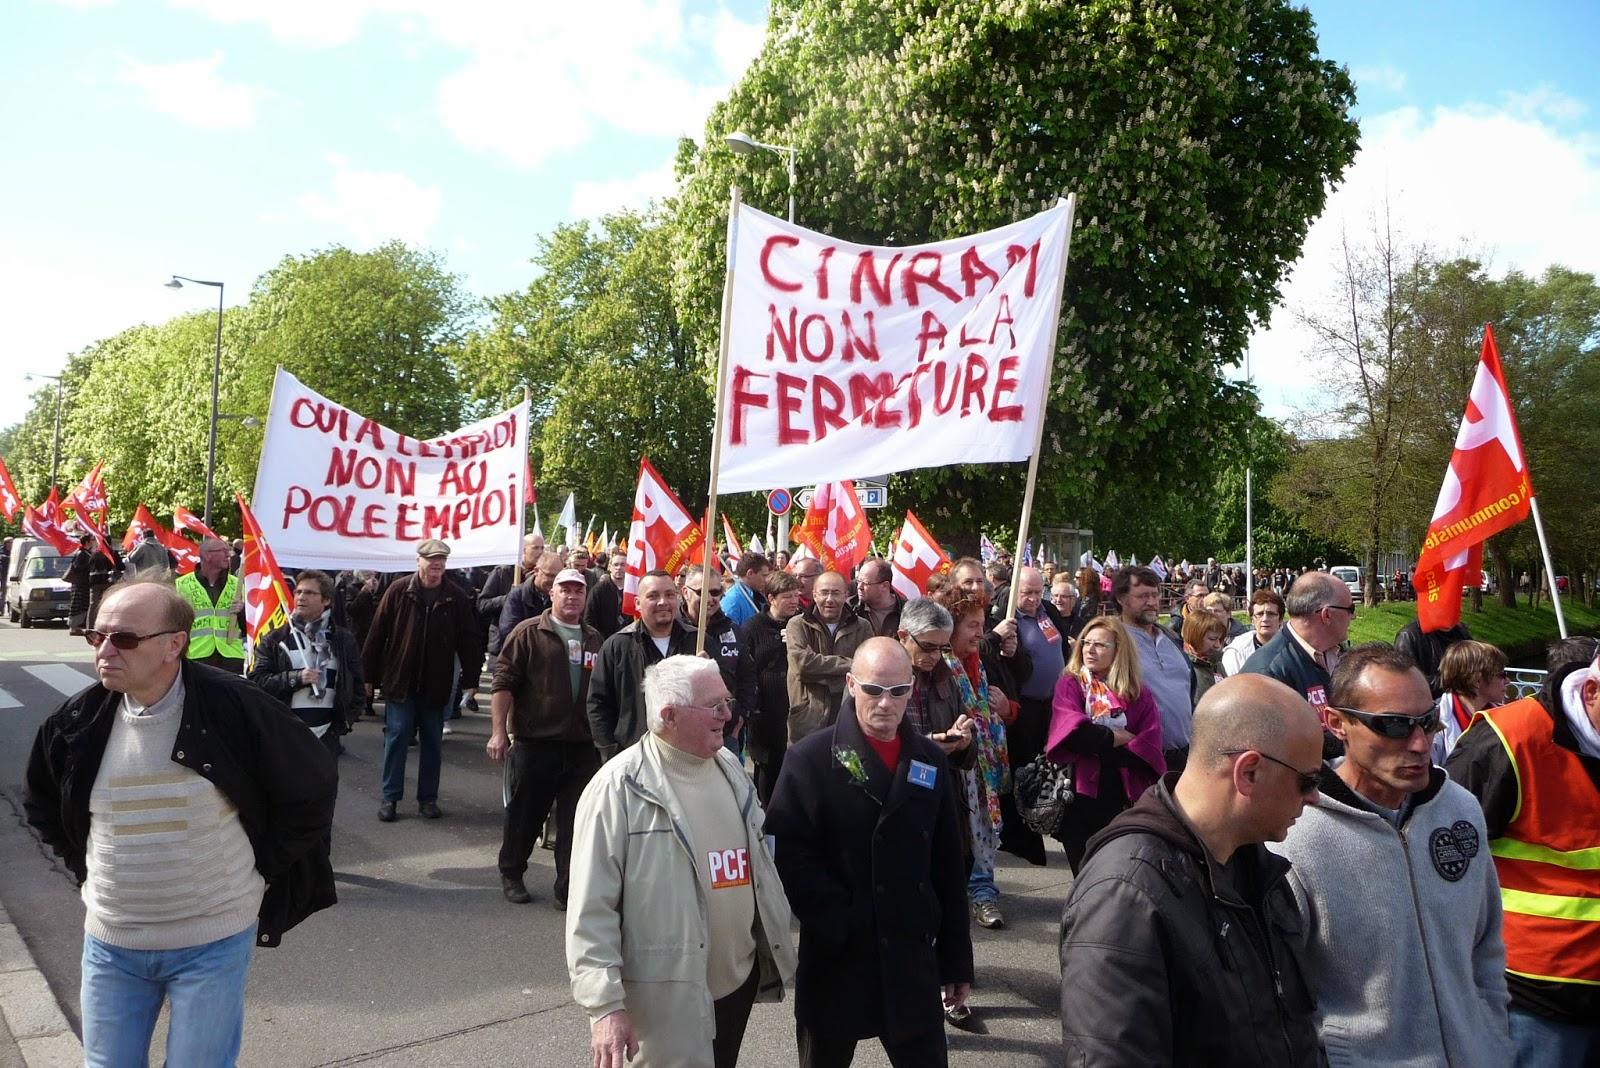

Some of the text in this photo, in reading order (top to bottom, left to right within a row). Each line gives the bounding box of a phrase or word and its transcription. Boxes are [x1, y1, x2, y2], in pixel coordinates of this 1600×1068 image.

[760, 234, 1041, 306] CINRAM
[766, 294, 1017, 363] NON A LA
[290, 398, 349, 441] OUI
[354, 419, 385, 451] A
[729, 353, 1024, 445] FERMETURE
[324, 446, 488, 497] NON AU
[283, 485, 388, 539] POLE
[708, 848, 747, 883] PCF
